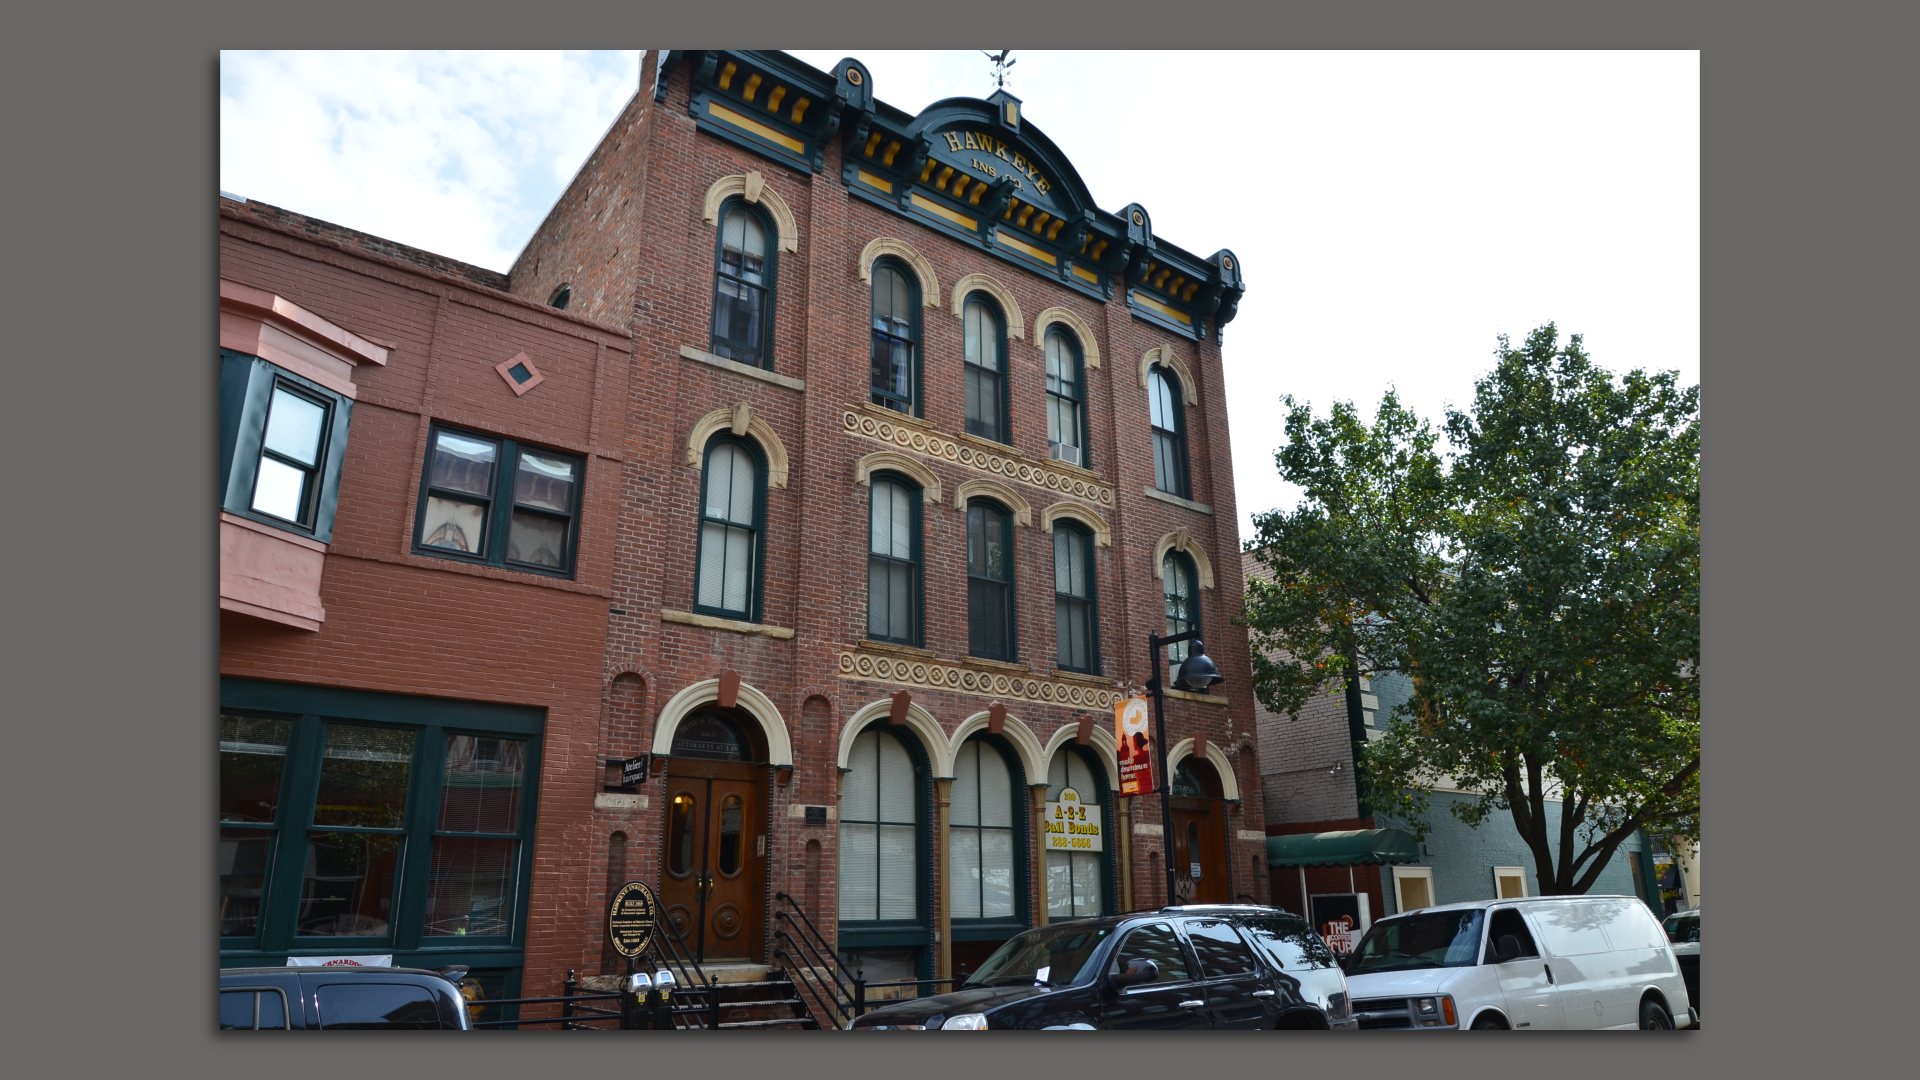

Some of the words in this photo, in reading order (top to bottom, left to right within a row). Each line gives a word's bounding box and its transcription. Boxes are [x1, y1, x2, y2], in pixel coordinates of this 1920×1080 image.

[943, 131, 1051, 196] HAWKEYE
[972, 158, 1000, 178] INS.
[677, 742, 714, 750] ATTORNEYS
[1055, 804, 1086, 820] A-2-Z
[1068, 821, 1099, 835] Bonds
[1052, 836, 1091, 848] 288-5656
[612, 888, 629, 916] HAWKEYE
[628, 884, 653, 905] INSURANCE
[1328, 921, 1350, 935] THE
[1330, 941, 1351, 954] CUP
